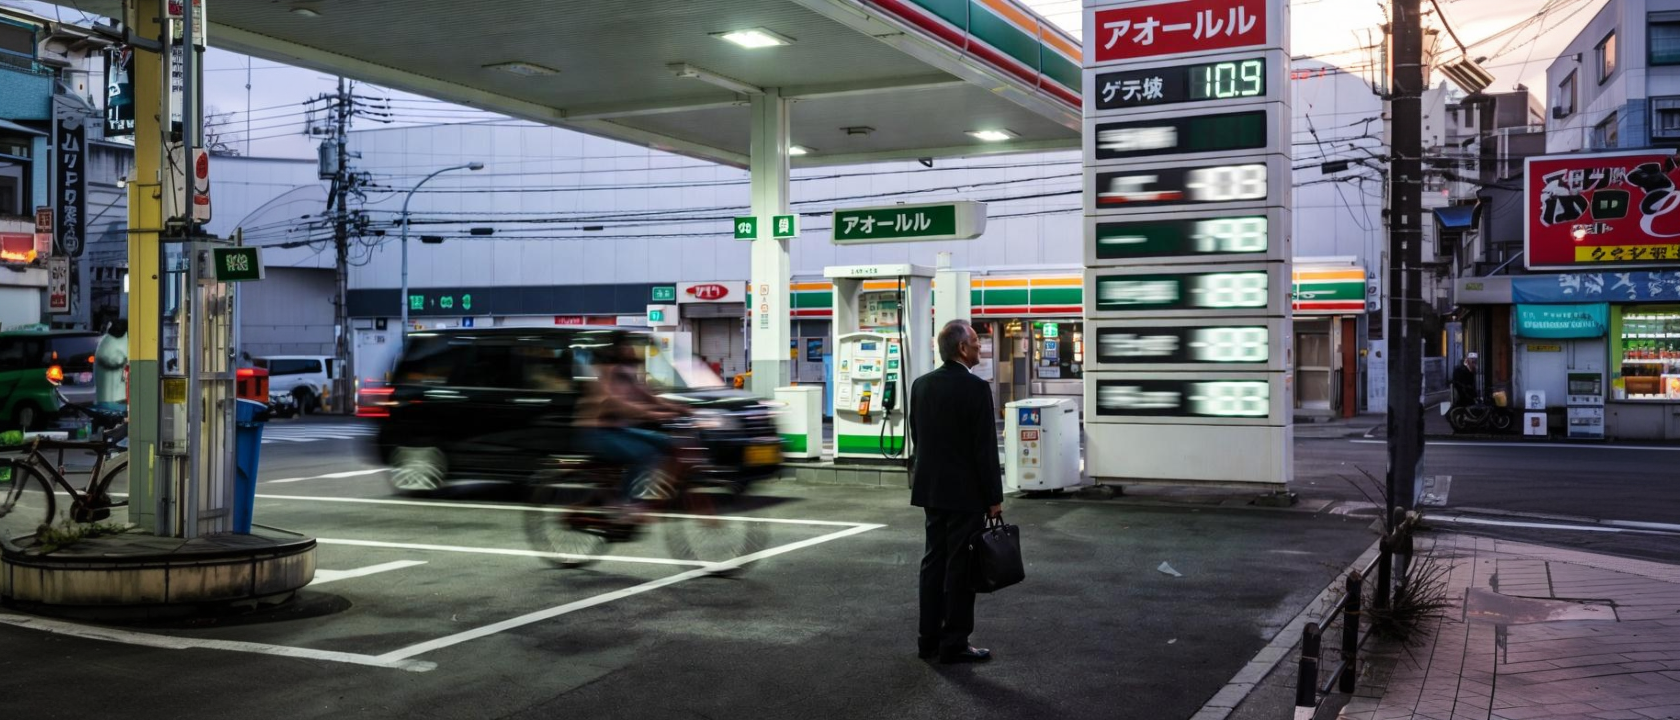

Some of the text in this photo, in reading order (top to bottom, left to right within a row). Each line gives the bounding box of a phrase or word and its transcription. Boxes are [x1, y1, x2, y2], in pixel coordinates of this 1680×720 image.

[1104, 6, 1257, 50] アオールル
[1206, 61, 1261, 98] 10.9
[842, 212, 931, 236] アオールル
